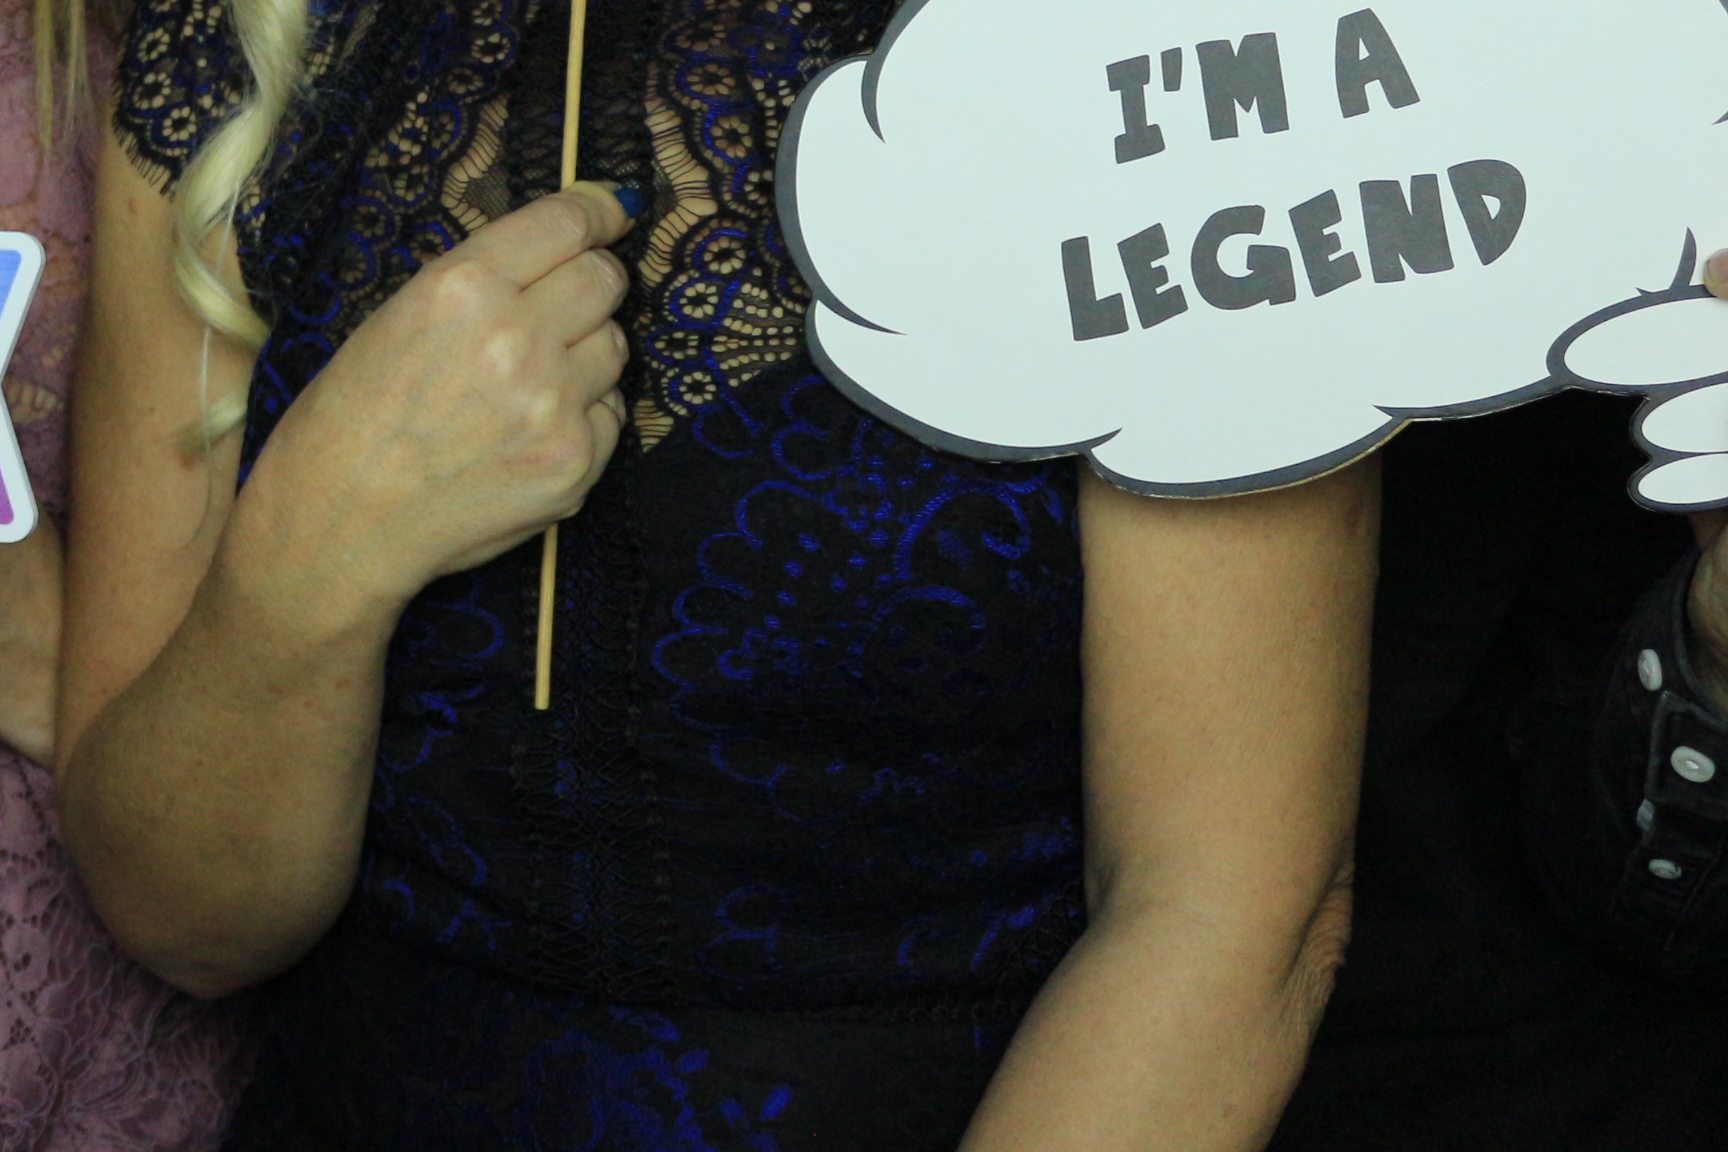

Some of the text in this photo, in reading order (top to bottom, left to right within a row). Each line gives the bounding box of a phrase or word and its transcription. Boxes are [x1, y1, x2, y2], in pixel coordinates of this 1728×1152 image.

[1106, 7, 1421, 164] I'M A
[1060, 159, 1527, 342] LEGEND
